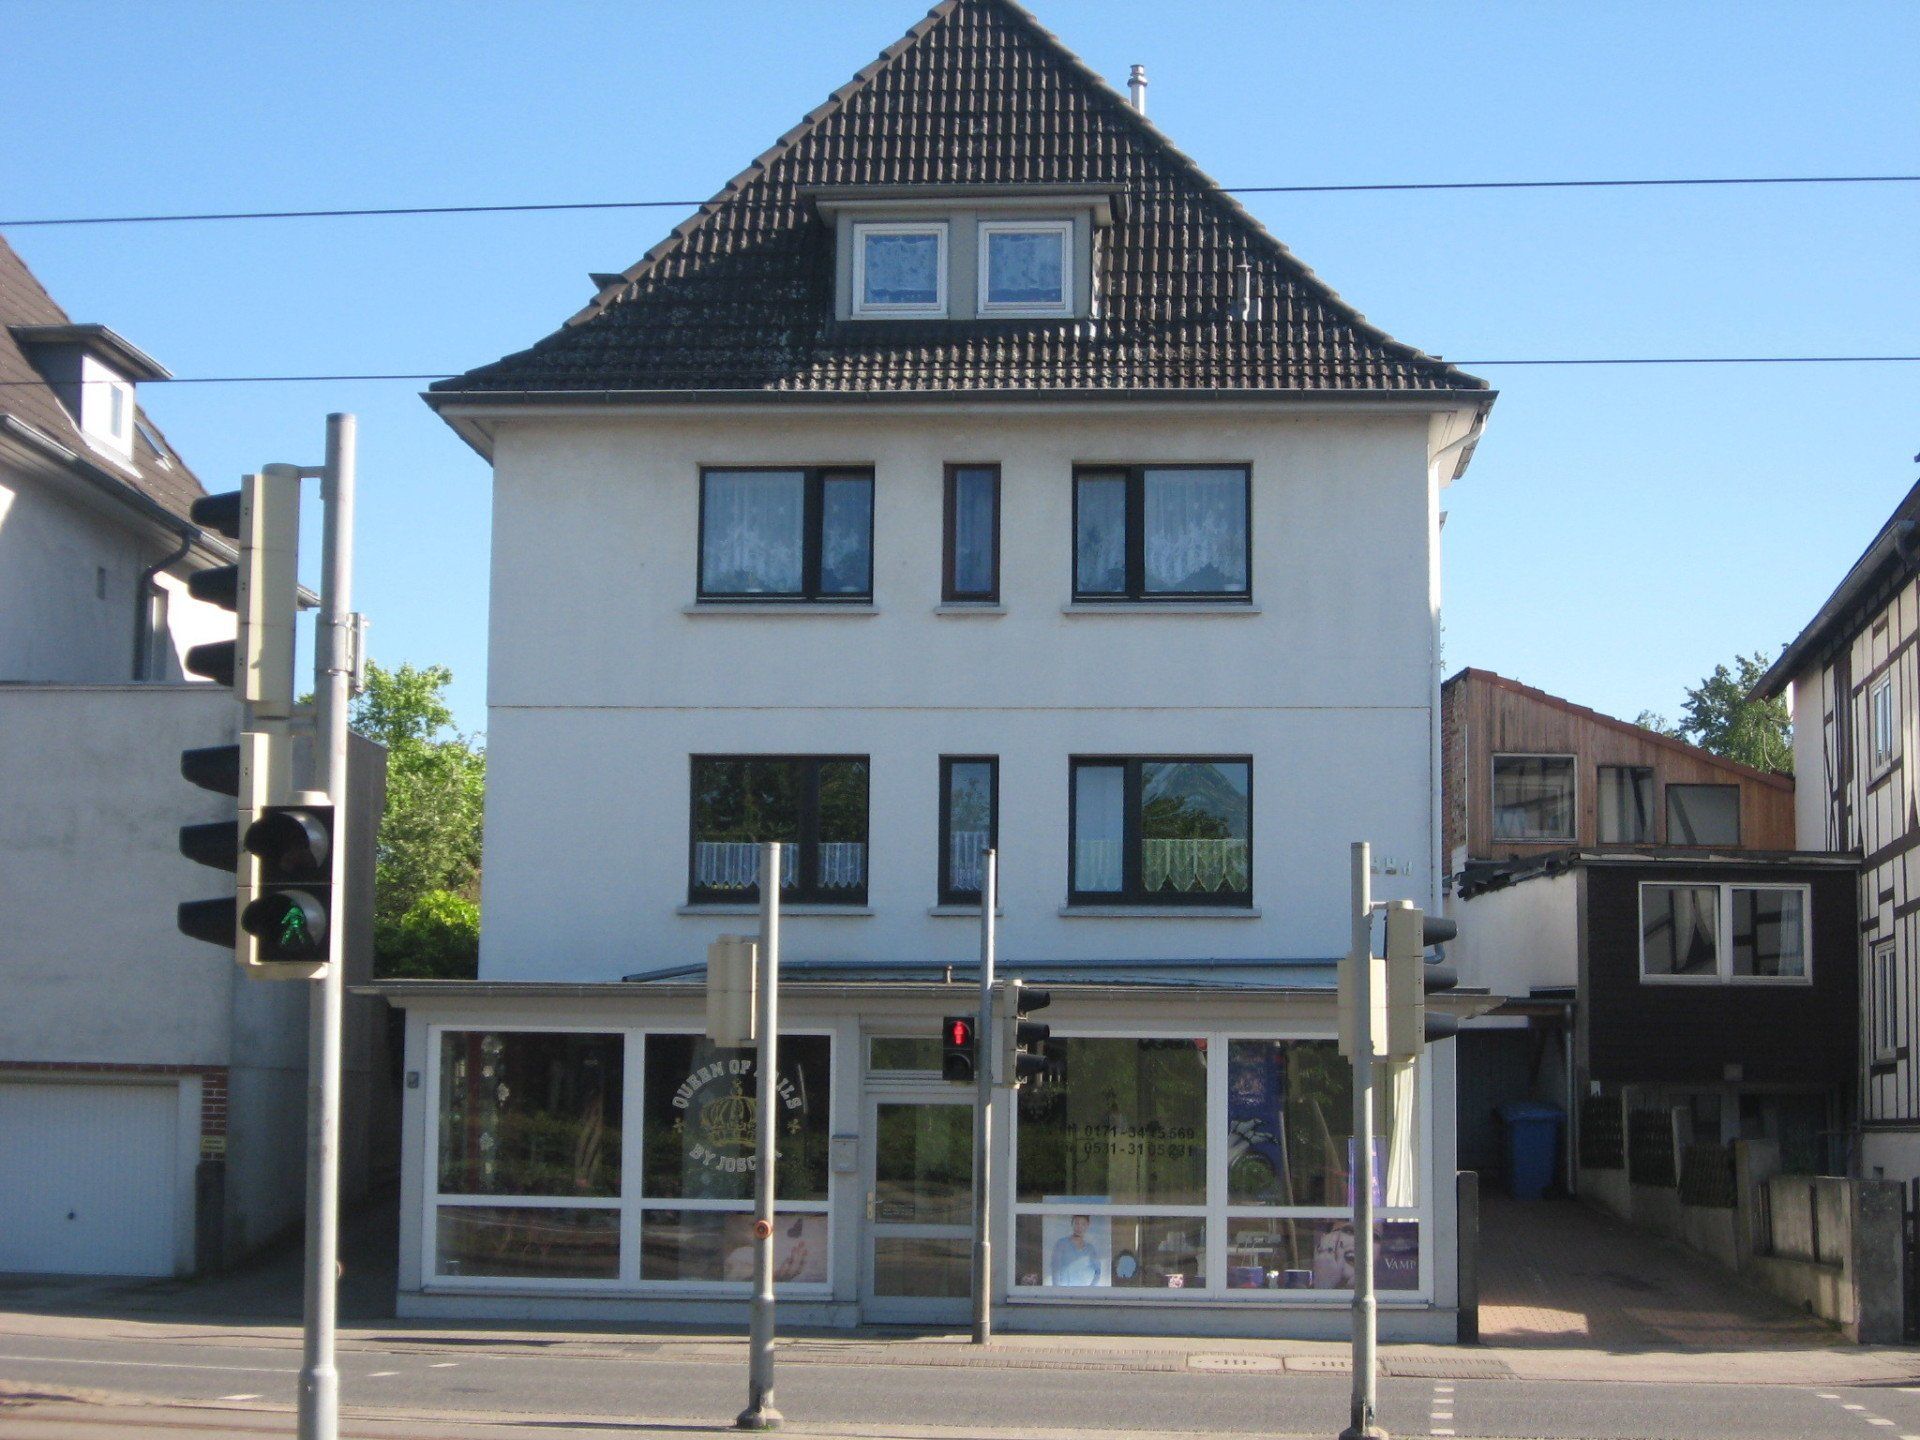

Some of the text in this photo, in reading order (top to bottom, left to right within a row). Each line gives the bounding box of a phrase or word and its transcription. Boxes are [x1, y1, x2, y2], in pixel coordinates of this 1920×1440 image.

[672, 1061, 725, 1109] QUEEN
[728, 1059, 751, 1075] OF
[688, 1143, 716, 1166] BY
